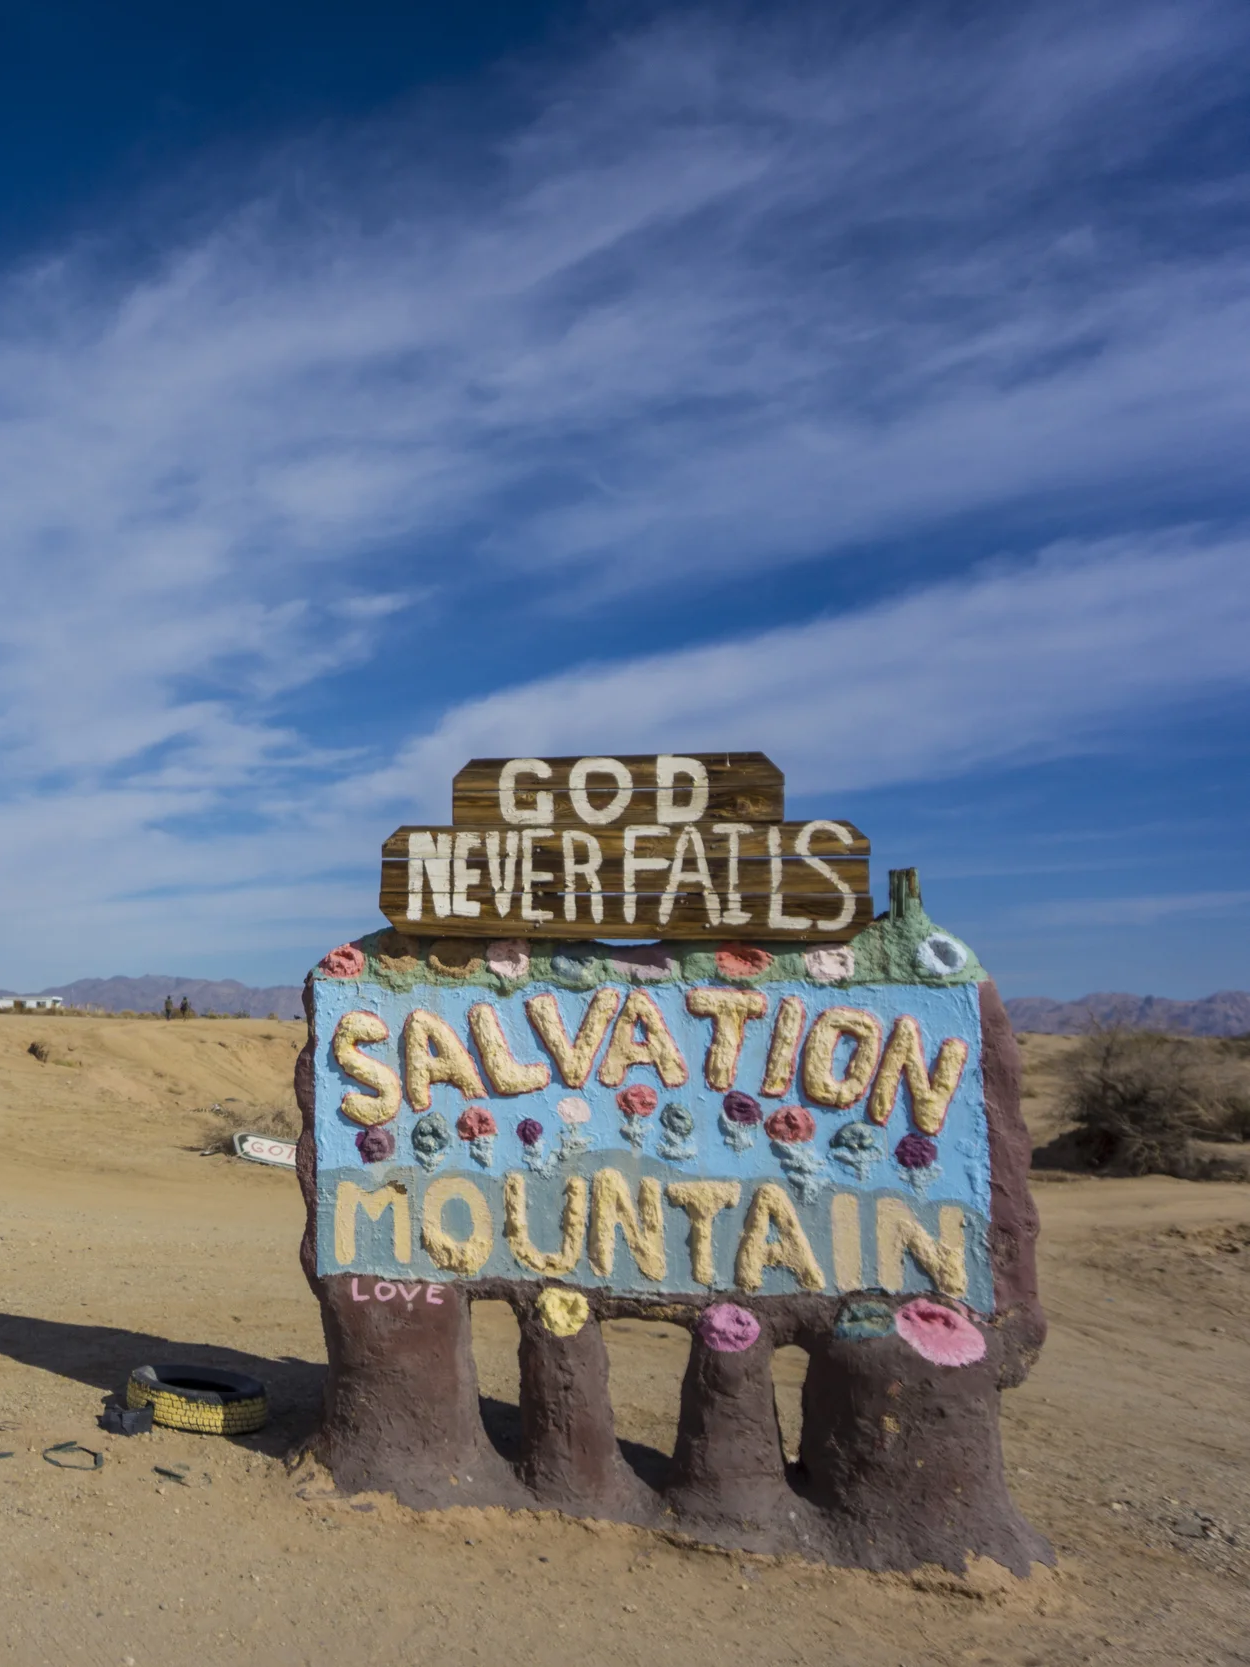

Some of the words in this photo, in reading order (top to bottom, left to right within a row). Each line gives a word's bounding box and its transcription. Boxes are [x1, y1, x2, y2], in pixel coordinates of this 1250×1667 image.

[498, 754, 710, 825] GOD
[408, 828, 605, 924] NEVER
[623, 820, 858, 931] FAILS
[333, 988, 969, 1136] SALVATION
[335, 1167, 967, 1299] MOUNTAIN
[351, 1278, 446, 1305] LOVE
